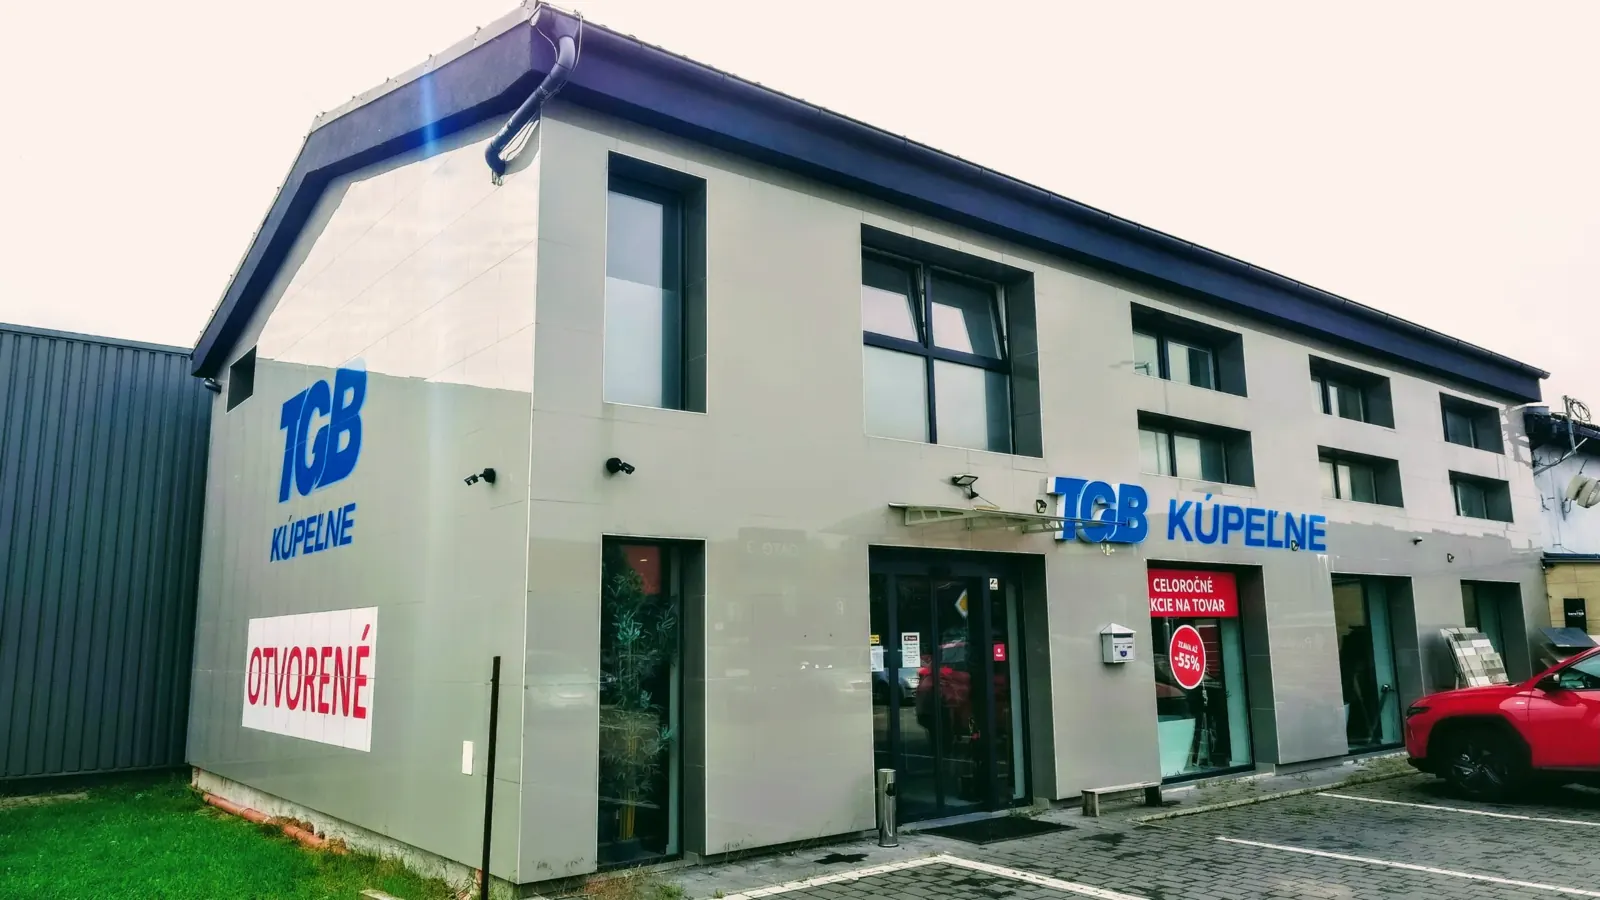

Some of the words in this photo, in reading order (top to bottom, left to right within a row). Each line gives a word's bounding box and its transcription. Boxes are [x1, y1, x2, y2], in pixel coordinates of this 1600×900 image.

[279, 357, 367, 503] TGB
[270, 503, 356, 562] KÚPEĽNE
[1047, 476, 1148, 543] TGB
[1167, 492, 1327, 551] KÚPEĽNE
[1149, 597, 1174, 612] KCIE
[1175, 598, 1191, 612] NA
[1192, 598, 1226, 612] TOVAR
[1153, 576, 1214, 593] CELOROČNÉ
[248, 623, 370, 719] OTVORENÉ
[1174, 651, 1200, 672] -55%
